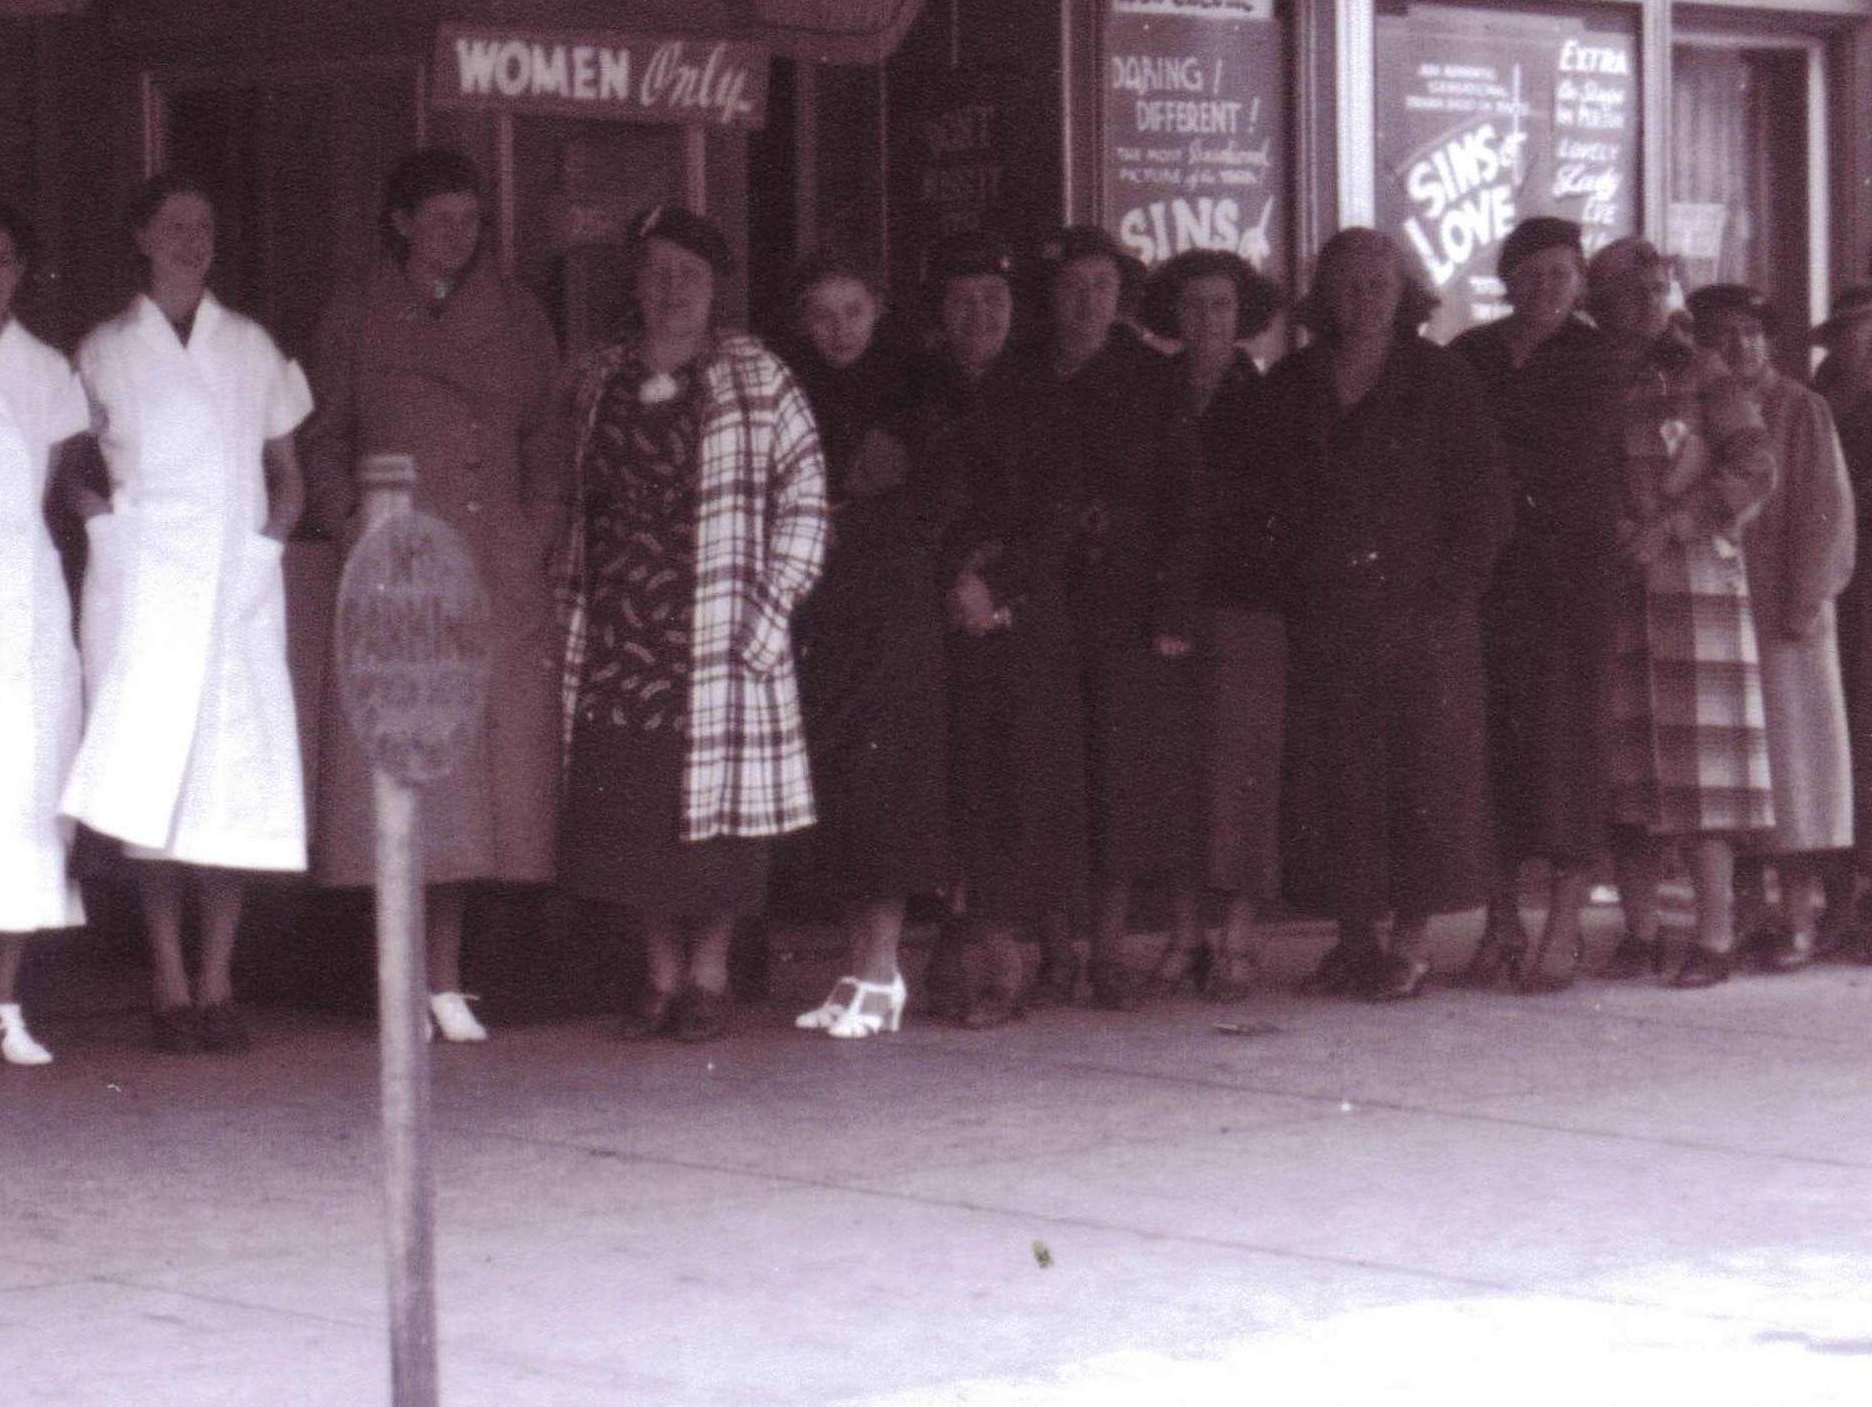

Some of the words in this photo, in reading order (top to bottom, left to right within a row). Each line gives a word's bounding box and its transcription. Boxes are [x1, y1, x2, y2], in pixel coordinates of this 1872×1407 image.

[457, 37, 630, 102] WOMEN
[639, 39, 754, 125] Only
[1110, 53, 1205, 97] DARING
[1558, 38, 1629, 75] EXTRA
[1136, 99, 1243, 136] DIFFERENT
[1407, 123, 1500, 220] SINS
[1120, 196, 1241, 269] SINS
[1403, 184, 1517, 285] LOVE
